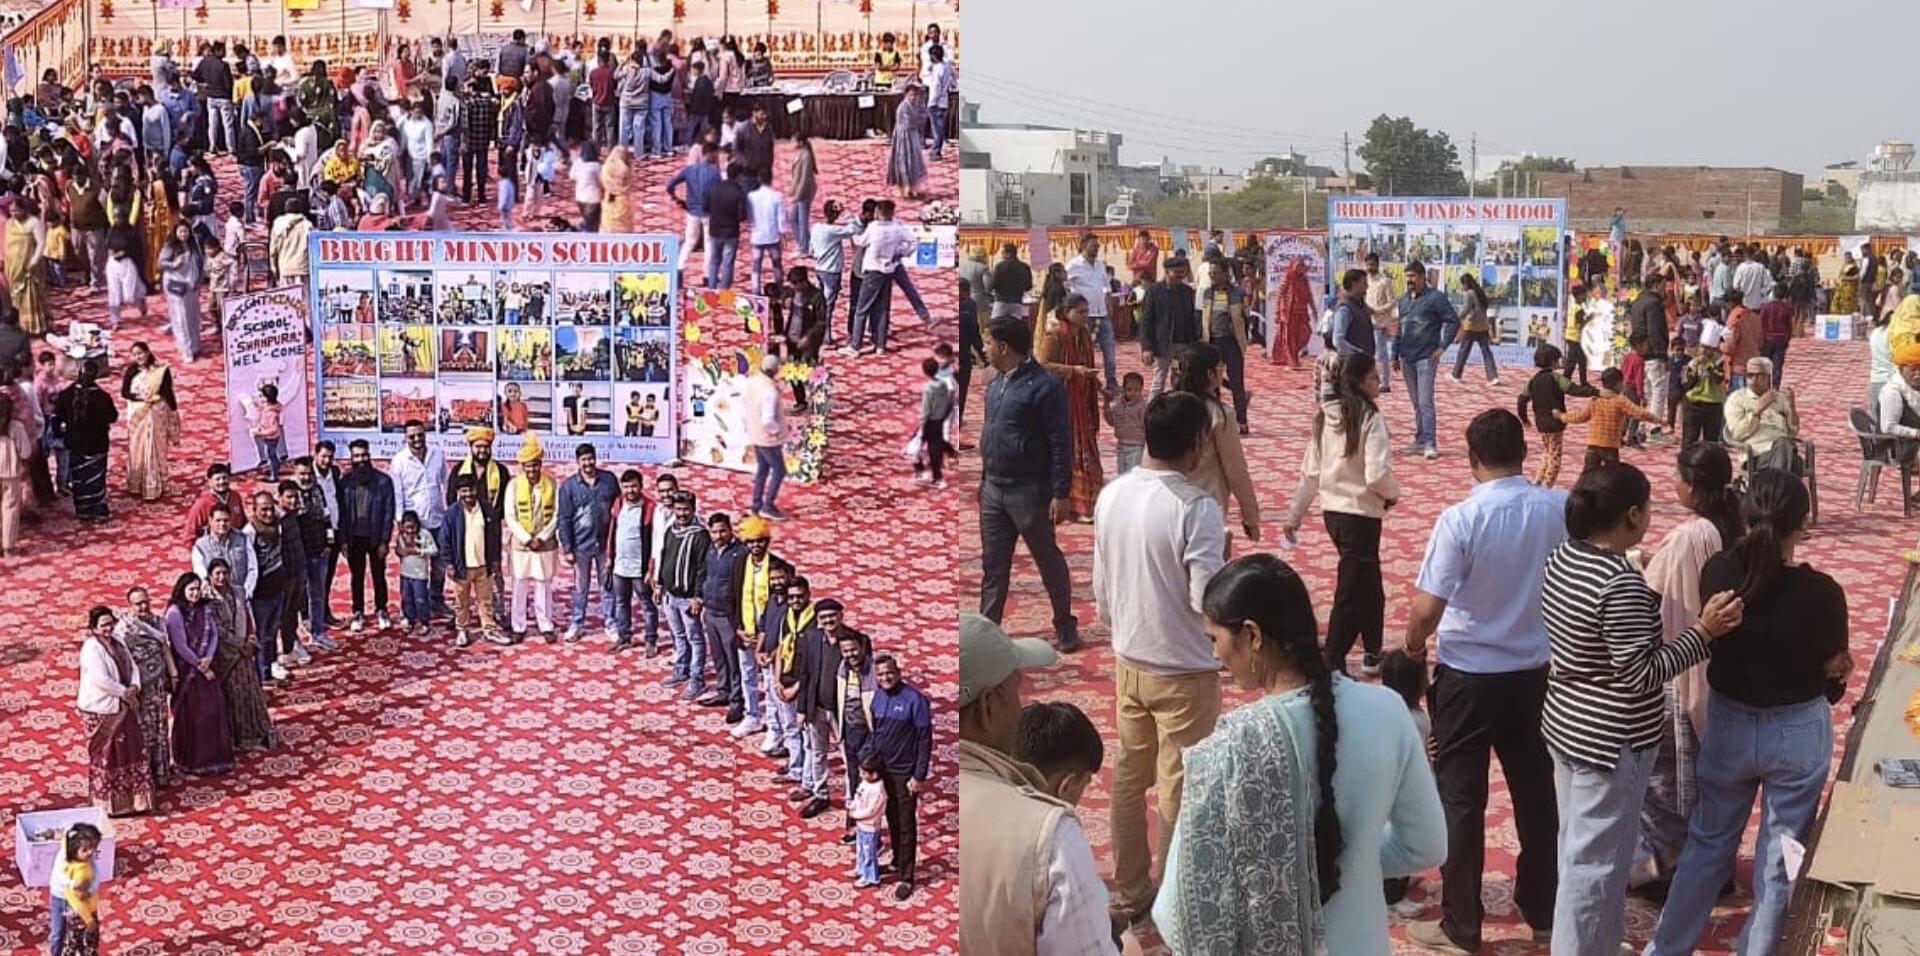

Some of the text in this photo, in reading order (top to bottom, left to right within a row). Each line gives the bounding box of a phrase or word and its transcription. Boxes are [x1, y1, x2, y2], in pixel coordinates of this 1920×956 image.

[1335, 201, 1556, 220] BRIGHT MIND'S SCHOOL
[320, 239, 668, 264] BRIGHT MIND'S SCHOOL
[243, 316, 291, 336] SCHOOL
